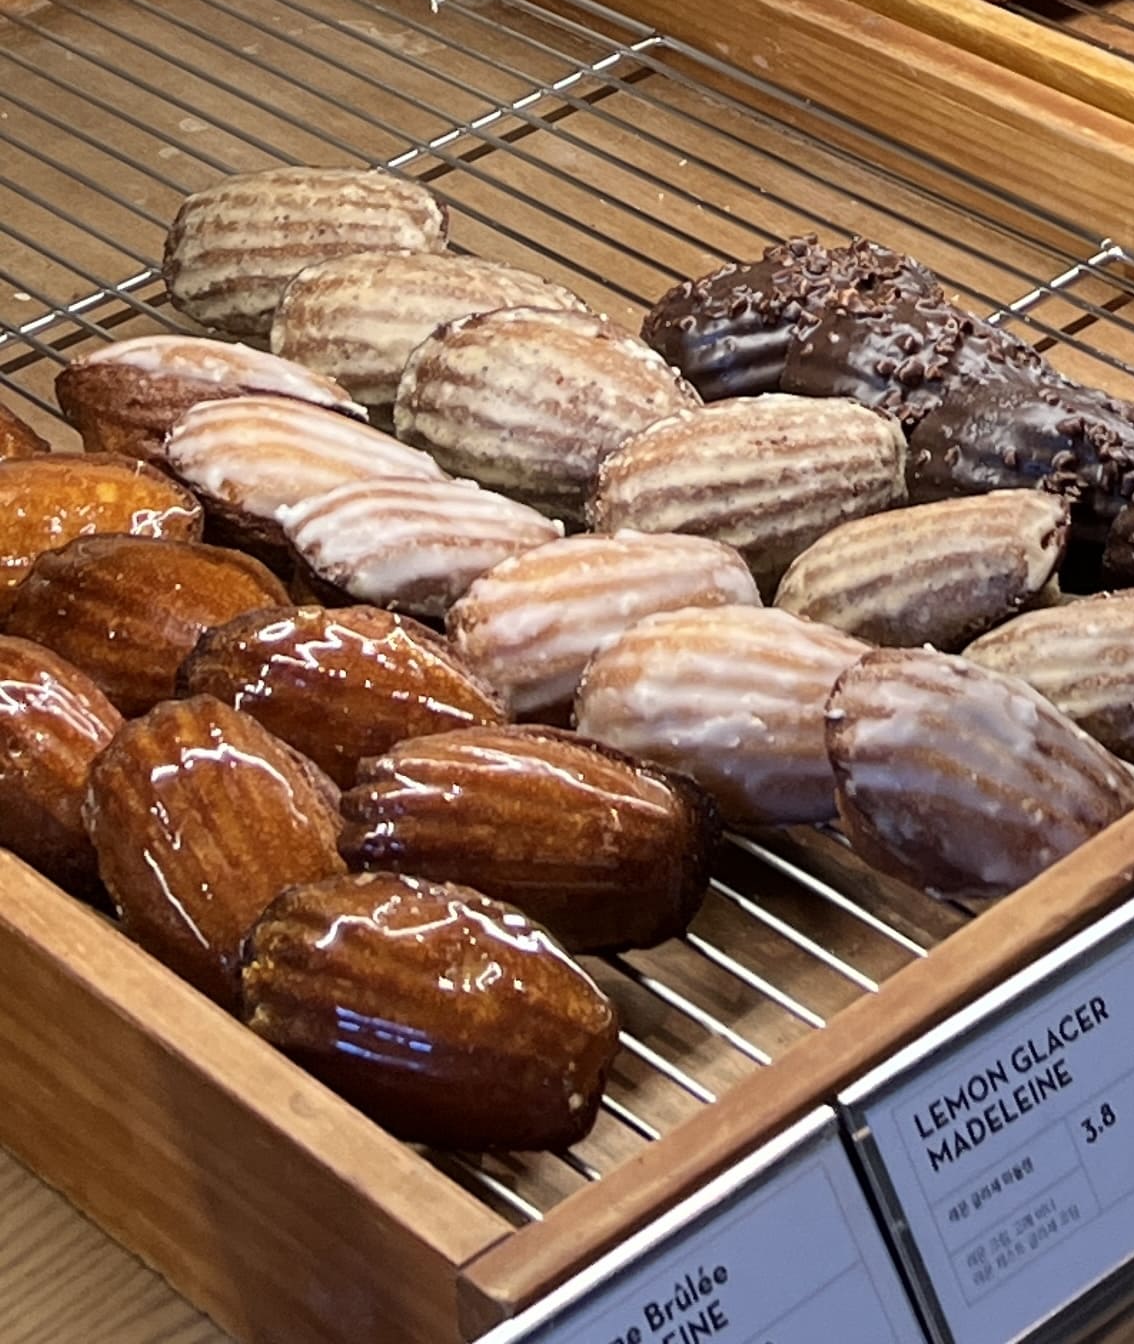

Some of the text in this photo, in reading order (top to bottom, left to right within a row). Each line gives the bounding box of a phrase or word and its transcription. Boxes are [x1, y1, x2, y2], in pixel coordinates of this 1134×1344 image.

[912, 996, 1110, 1139] LEMON GLACER
[926, 1059, 1073, 1173] MADELEINE
[1081, 1103, 1117, 1144] 3.8
[643, 1265, 728, 1332] Brûlée
